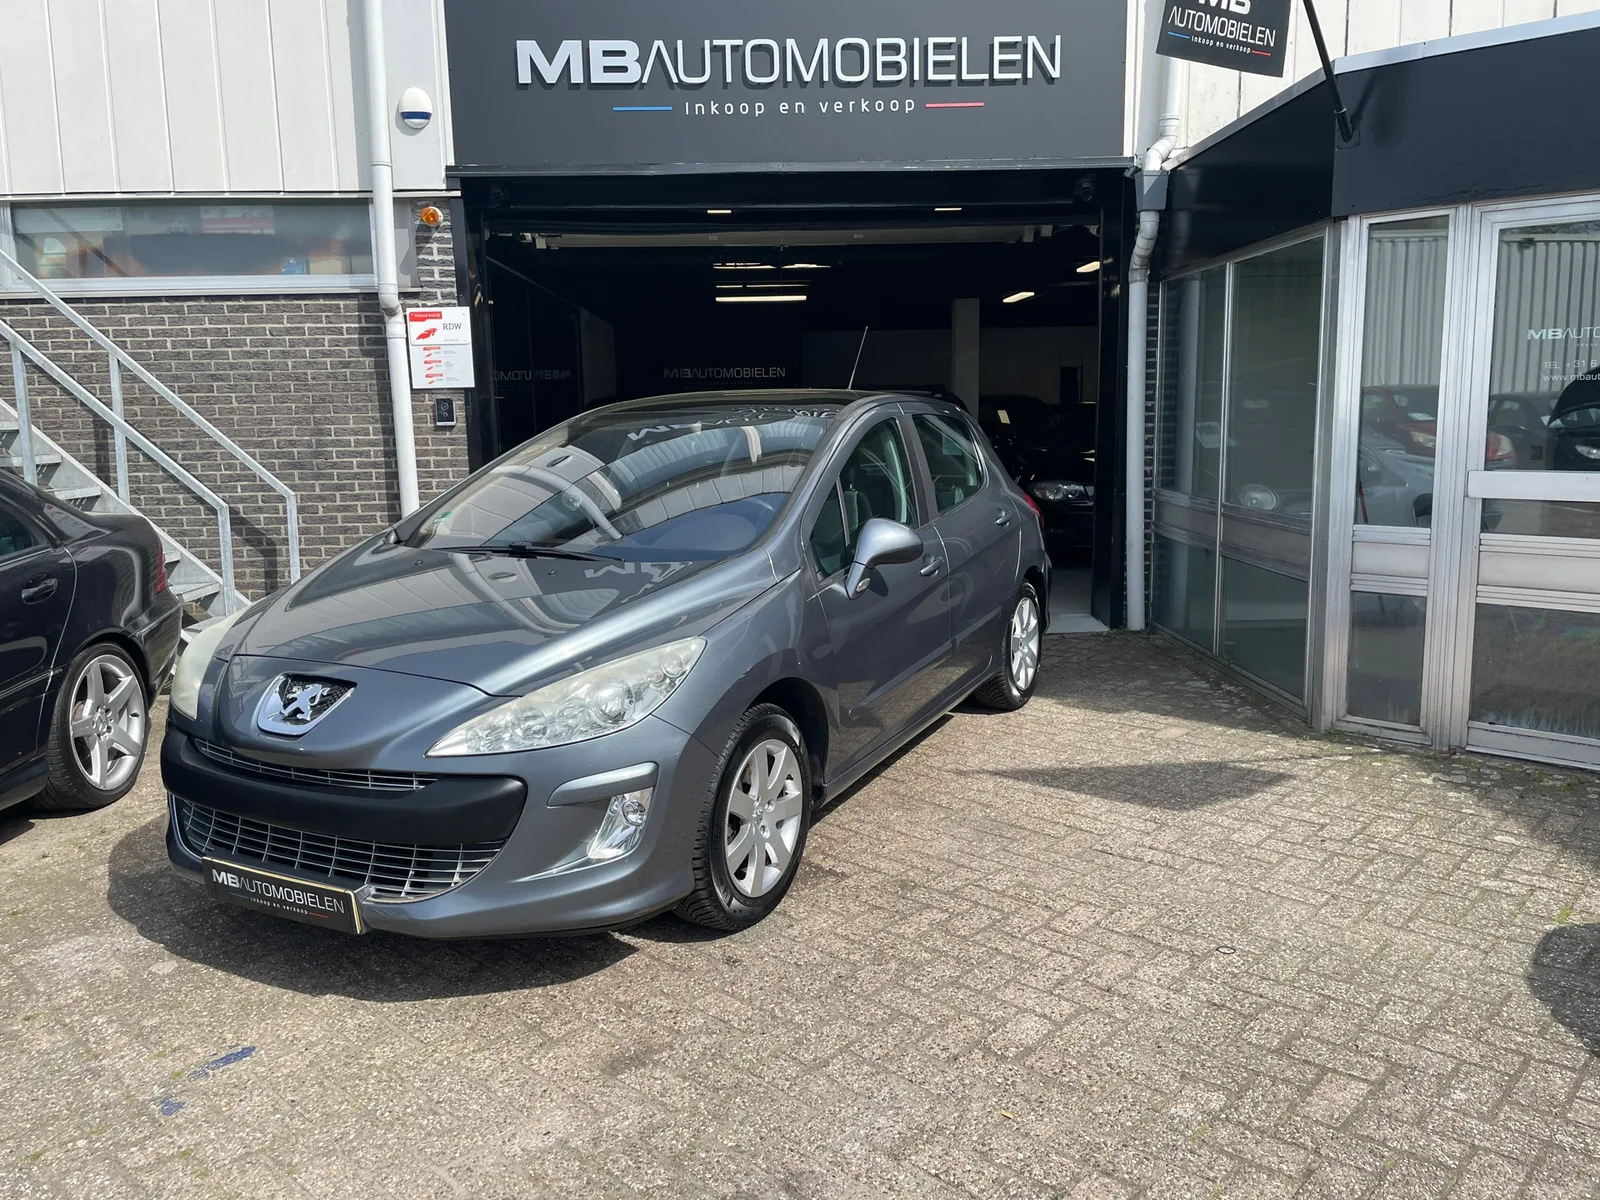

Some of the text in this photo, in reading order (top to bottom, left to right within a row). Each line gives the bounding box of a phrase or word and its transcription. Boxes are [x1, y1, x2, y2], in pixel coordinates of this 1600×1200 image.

[1198, 0, 1251, 15] B
[1168, 5, 1276, 47] AUTOMOBIELEN
[1226, 43, 1251, 54] verkoop
[779, 101, 804, 114] en
[819, 98, 915, 114] verkoop
[442, 322, 462, 331] RDW
[1565, 359, 1586, 368] +31
[1590, 359, 1598, 368] 6
